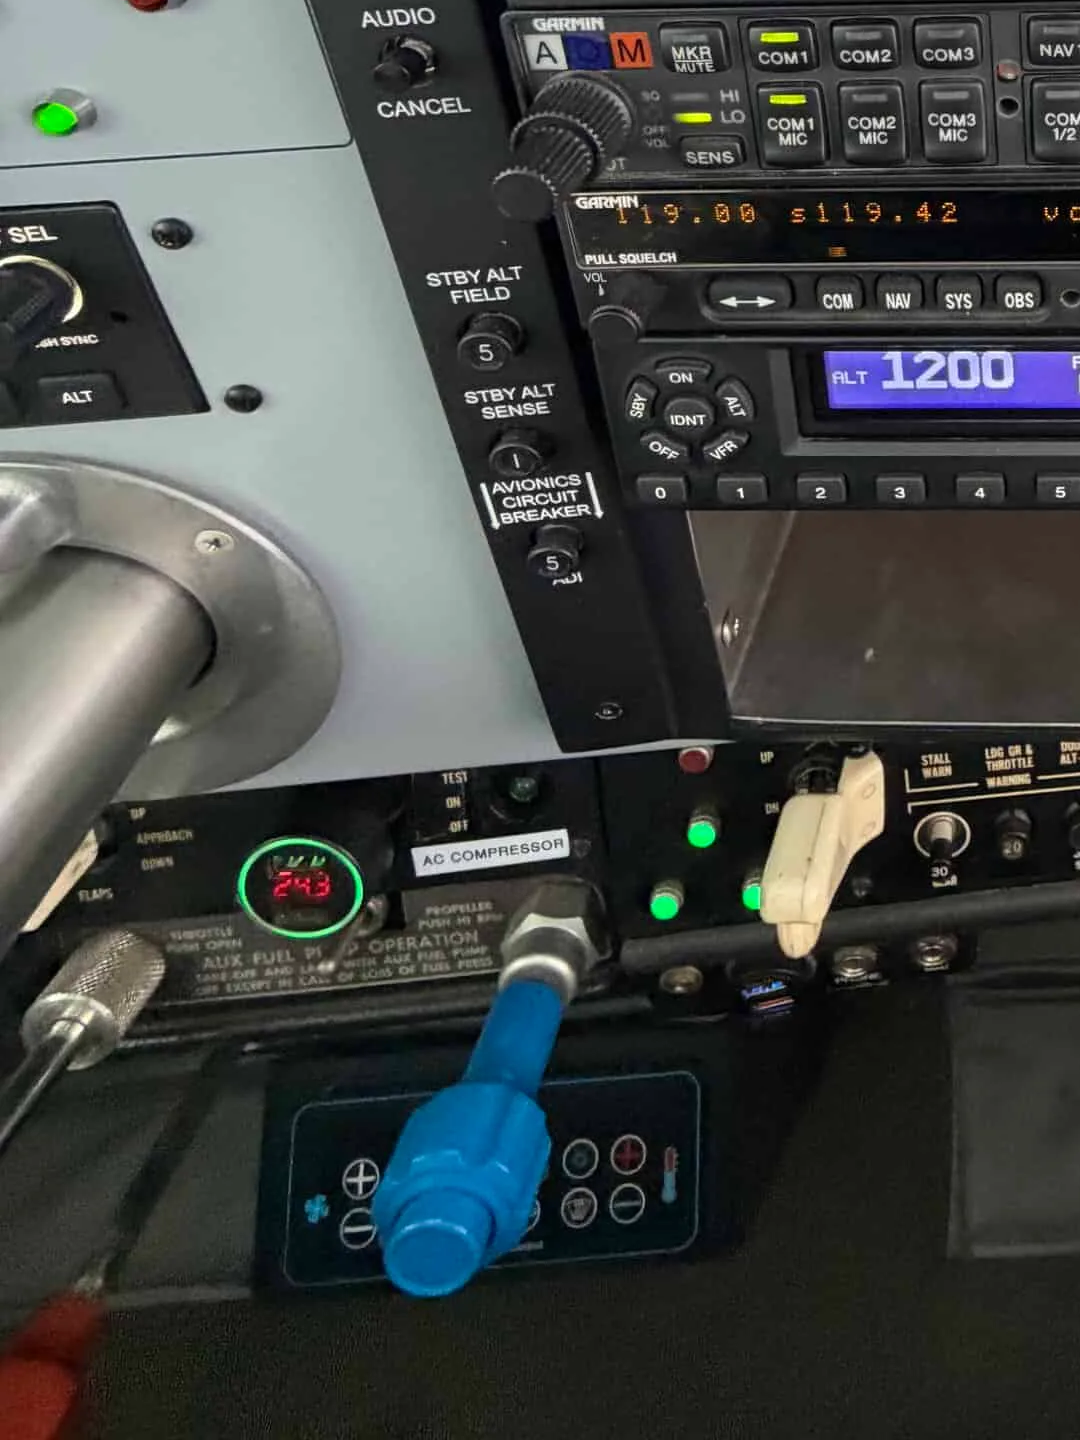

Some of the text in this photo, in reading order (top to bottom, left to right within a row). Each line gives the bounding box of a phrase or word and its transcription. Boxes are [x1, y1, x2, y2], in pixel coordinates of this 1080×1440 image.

[361, 8, 436, 28] AUDIO
[533, 18, 605, 32] GARMIN
[535, 42, 553, 63] A
[619, 36, 645, 62] M
[671, 46, 712, 60] MKR
[840, 49, 891, 63] COM2
[922, 47, 974, 61] COM3
[758, 51, 808, 66] COM1
[675, 61, 716, 74] MUTE
[720, 90, 739, 103] HI
[377, 97, 471, 118] CANCEL
[721, 109, 745, 124] LO
[768, 117, 814, 130] COM1
[848, 116, 896, 130] COM2
[928, 113, 976, 127] COM3
[779, 132, 808, 146] MIC
[859, 131, 888, 145] MIC
[939, 128, 968, 142] MIC
[1053, 127, 1077, 142] 1/2
[686, 151, 734, 165] SENS
[576, 195, 639, 210] GARMIN
[8, 225, 58, 243] SEL
[585, 251, 676, 265] PULL SQUELCH
[426, 266, 523, 288] STBY ALT
[584, 273, 607, 283] VOL
[450, 287, 510, 304] FIELD
[823, 294, 853, 310] COM
[886, 294, 911, 309] NAV
[945, 294, 972, 310] SYS
[1005, 293, 1034, 308] OBS
[60, 334, 99, 346] SYNC
[669, 372, 693, 384] ON
[832, 351, 1015, 390] ALT 1200
[62, 390, 93, 404] ALT
[464, 384, 556, 404] STBY ALT
[481, 401, 551, 420] SENSE
[630, 392, 648, 419] SBY
[724, 395, 746, 419] ALT
[670, 414, 705, 426] IDNT
[649, 440, 679, 461] OFF
[710, 439, 737, 461] VFR
[491, 474, 581, 494] AVIONICS
[502, 489, 579, 509] CIRCUIT
[500, 503, 591, 525] BREAKER
[760, 752, 774, 764] UP
[921, 752, 951, 767] STALL
[985, 756, 1034, 772] THROTTLE
[922, 765, 952, 779] WARN
[986, 773, 1031, 788] WARNING
[423, 838, 564, 866] AC COMPRESSOR
[931, 867, 948, 877] 30
[78, 888, 113, 902] FLAPS
